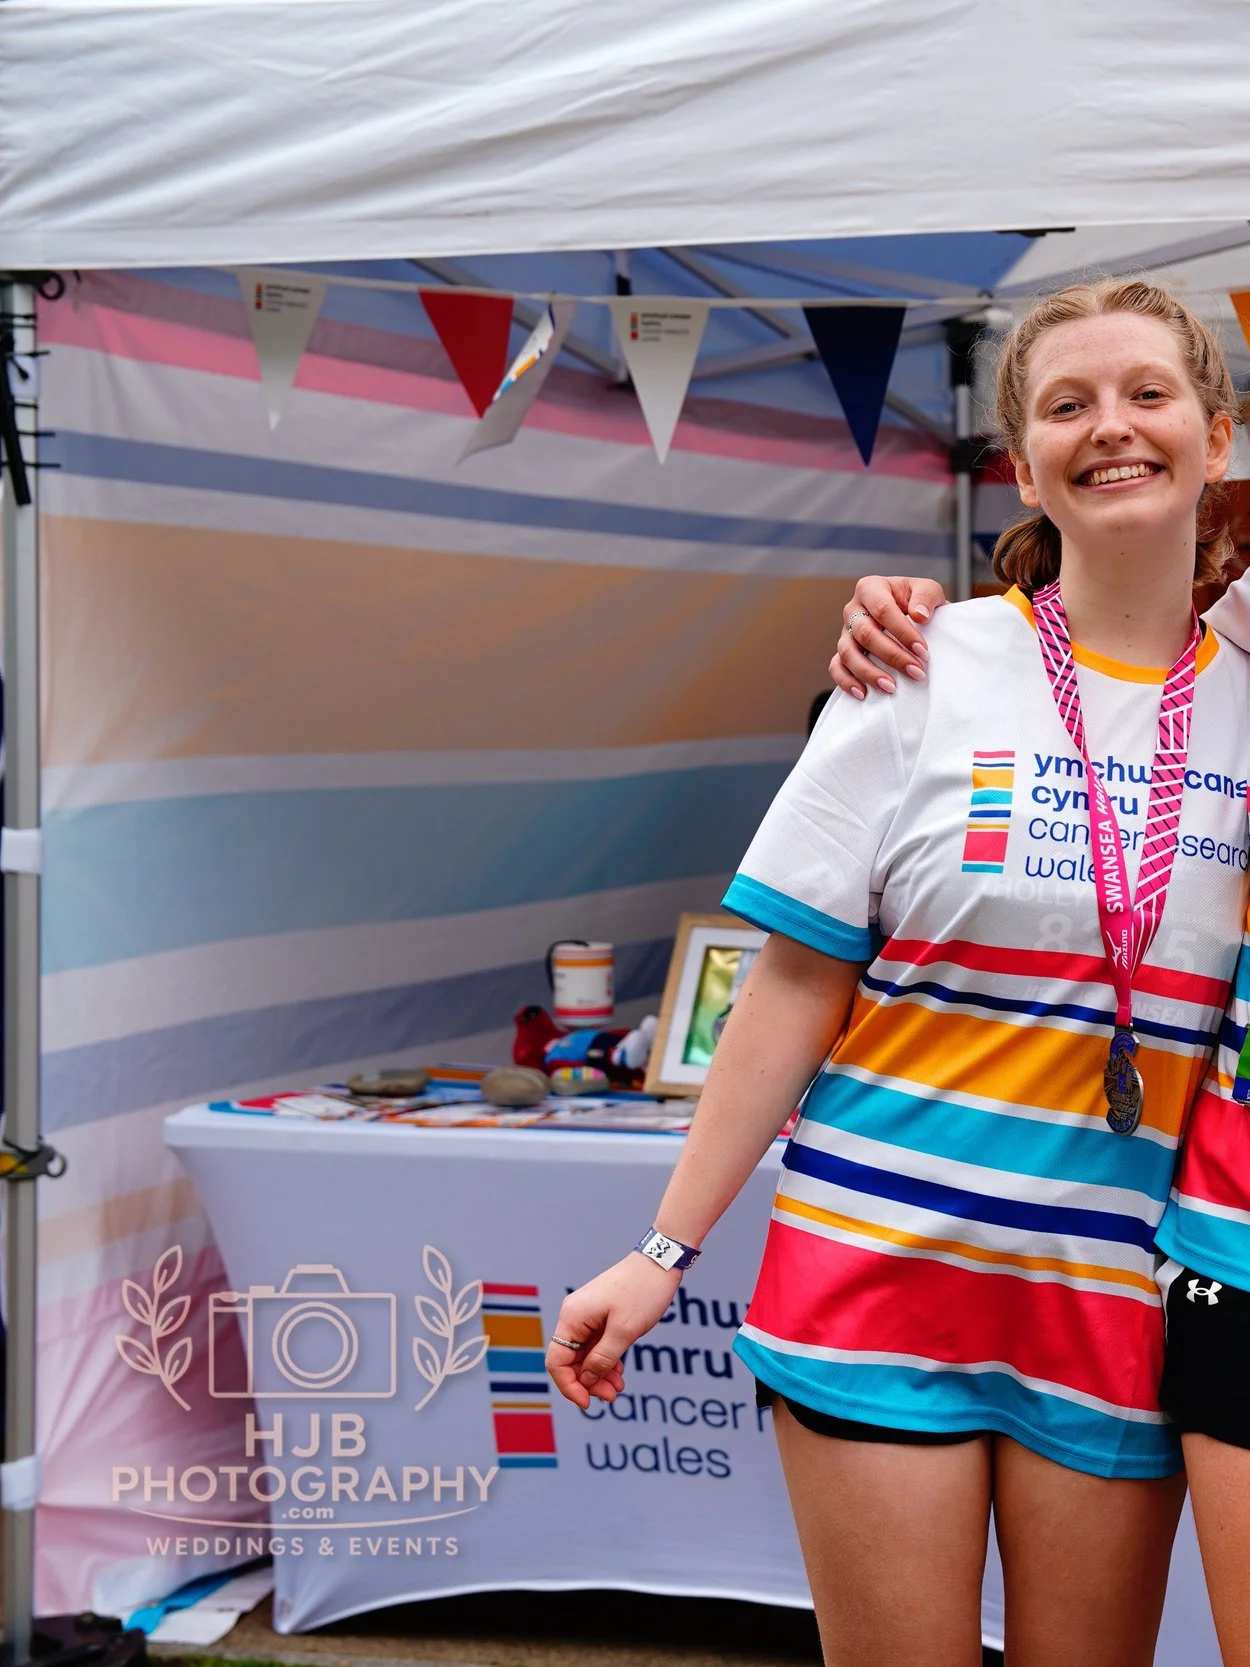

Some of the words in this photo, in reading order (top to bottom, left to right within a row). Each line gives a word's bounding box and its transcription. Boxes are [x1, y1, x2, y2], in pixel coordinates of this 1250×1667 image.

[1184, 769, 1248, 799] cans
[1028, 816, 1146, 852] caner
[1025, 854, 1097, 884] wale
[1097, 819, 1125, 914] SWANSEA
[585, 1436, 732, 1481] wales
